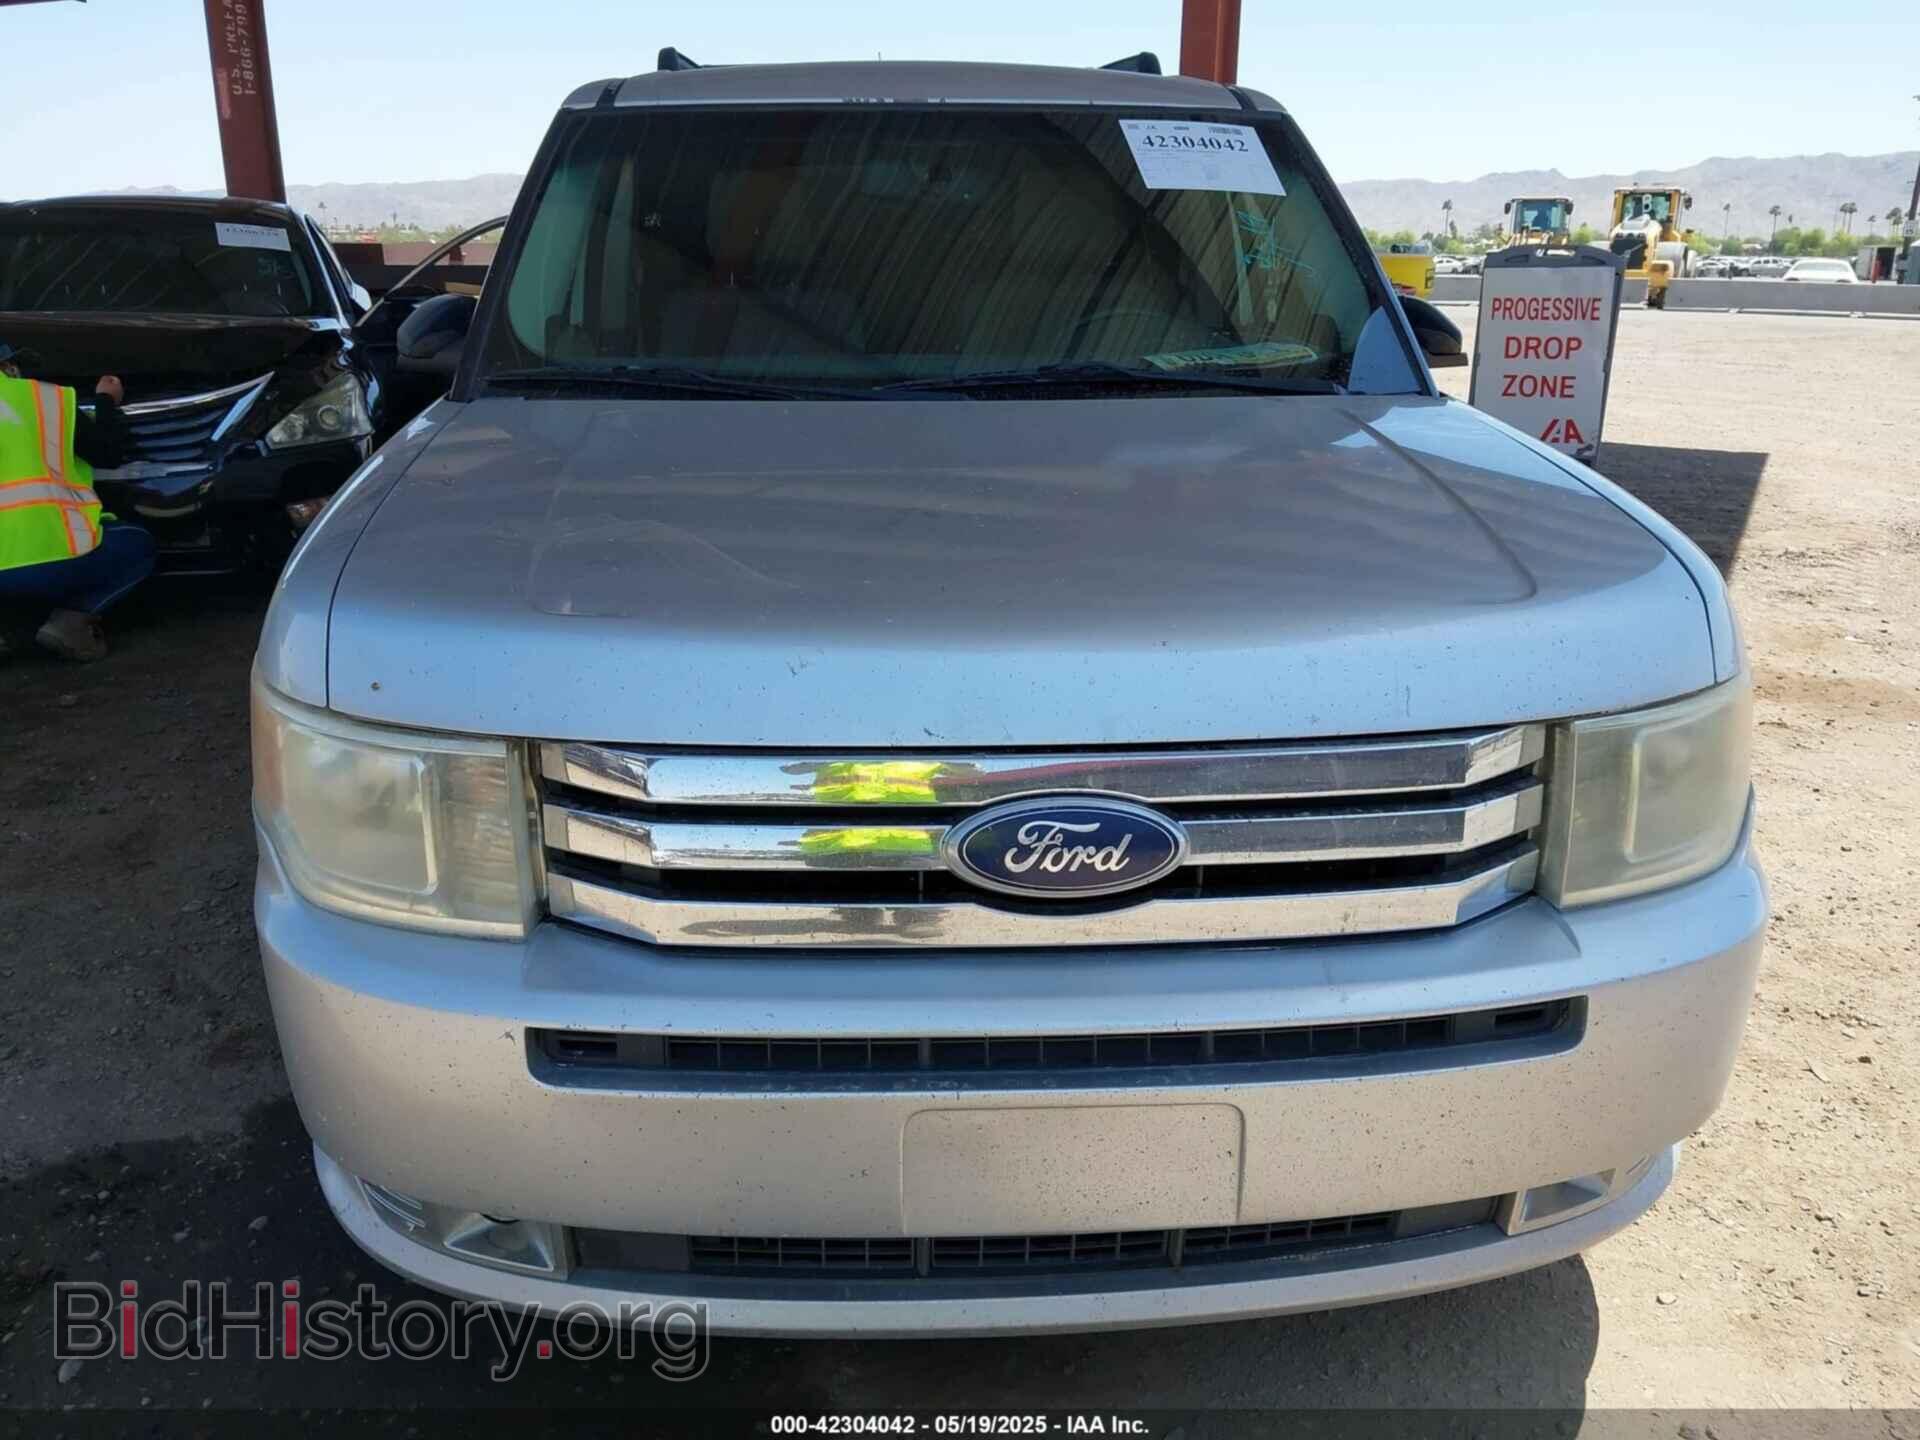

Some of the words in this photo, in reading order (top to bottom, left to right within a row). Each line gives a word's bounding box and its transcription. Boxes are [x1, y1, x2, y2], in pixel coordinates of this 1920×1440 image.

[1142, 135, 1249, 152] 42304042
[1491, 297, 1602, 321] PROGESSIVE
[1504, 336, 1583, 360] DROP
[1501, 375, 1577, 398] ZONE
[1003, 820, 1133, 873] Ford
